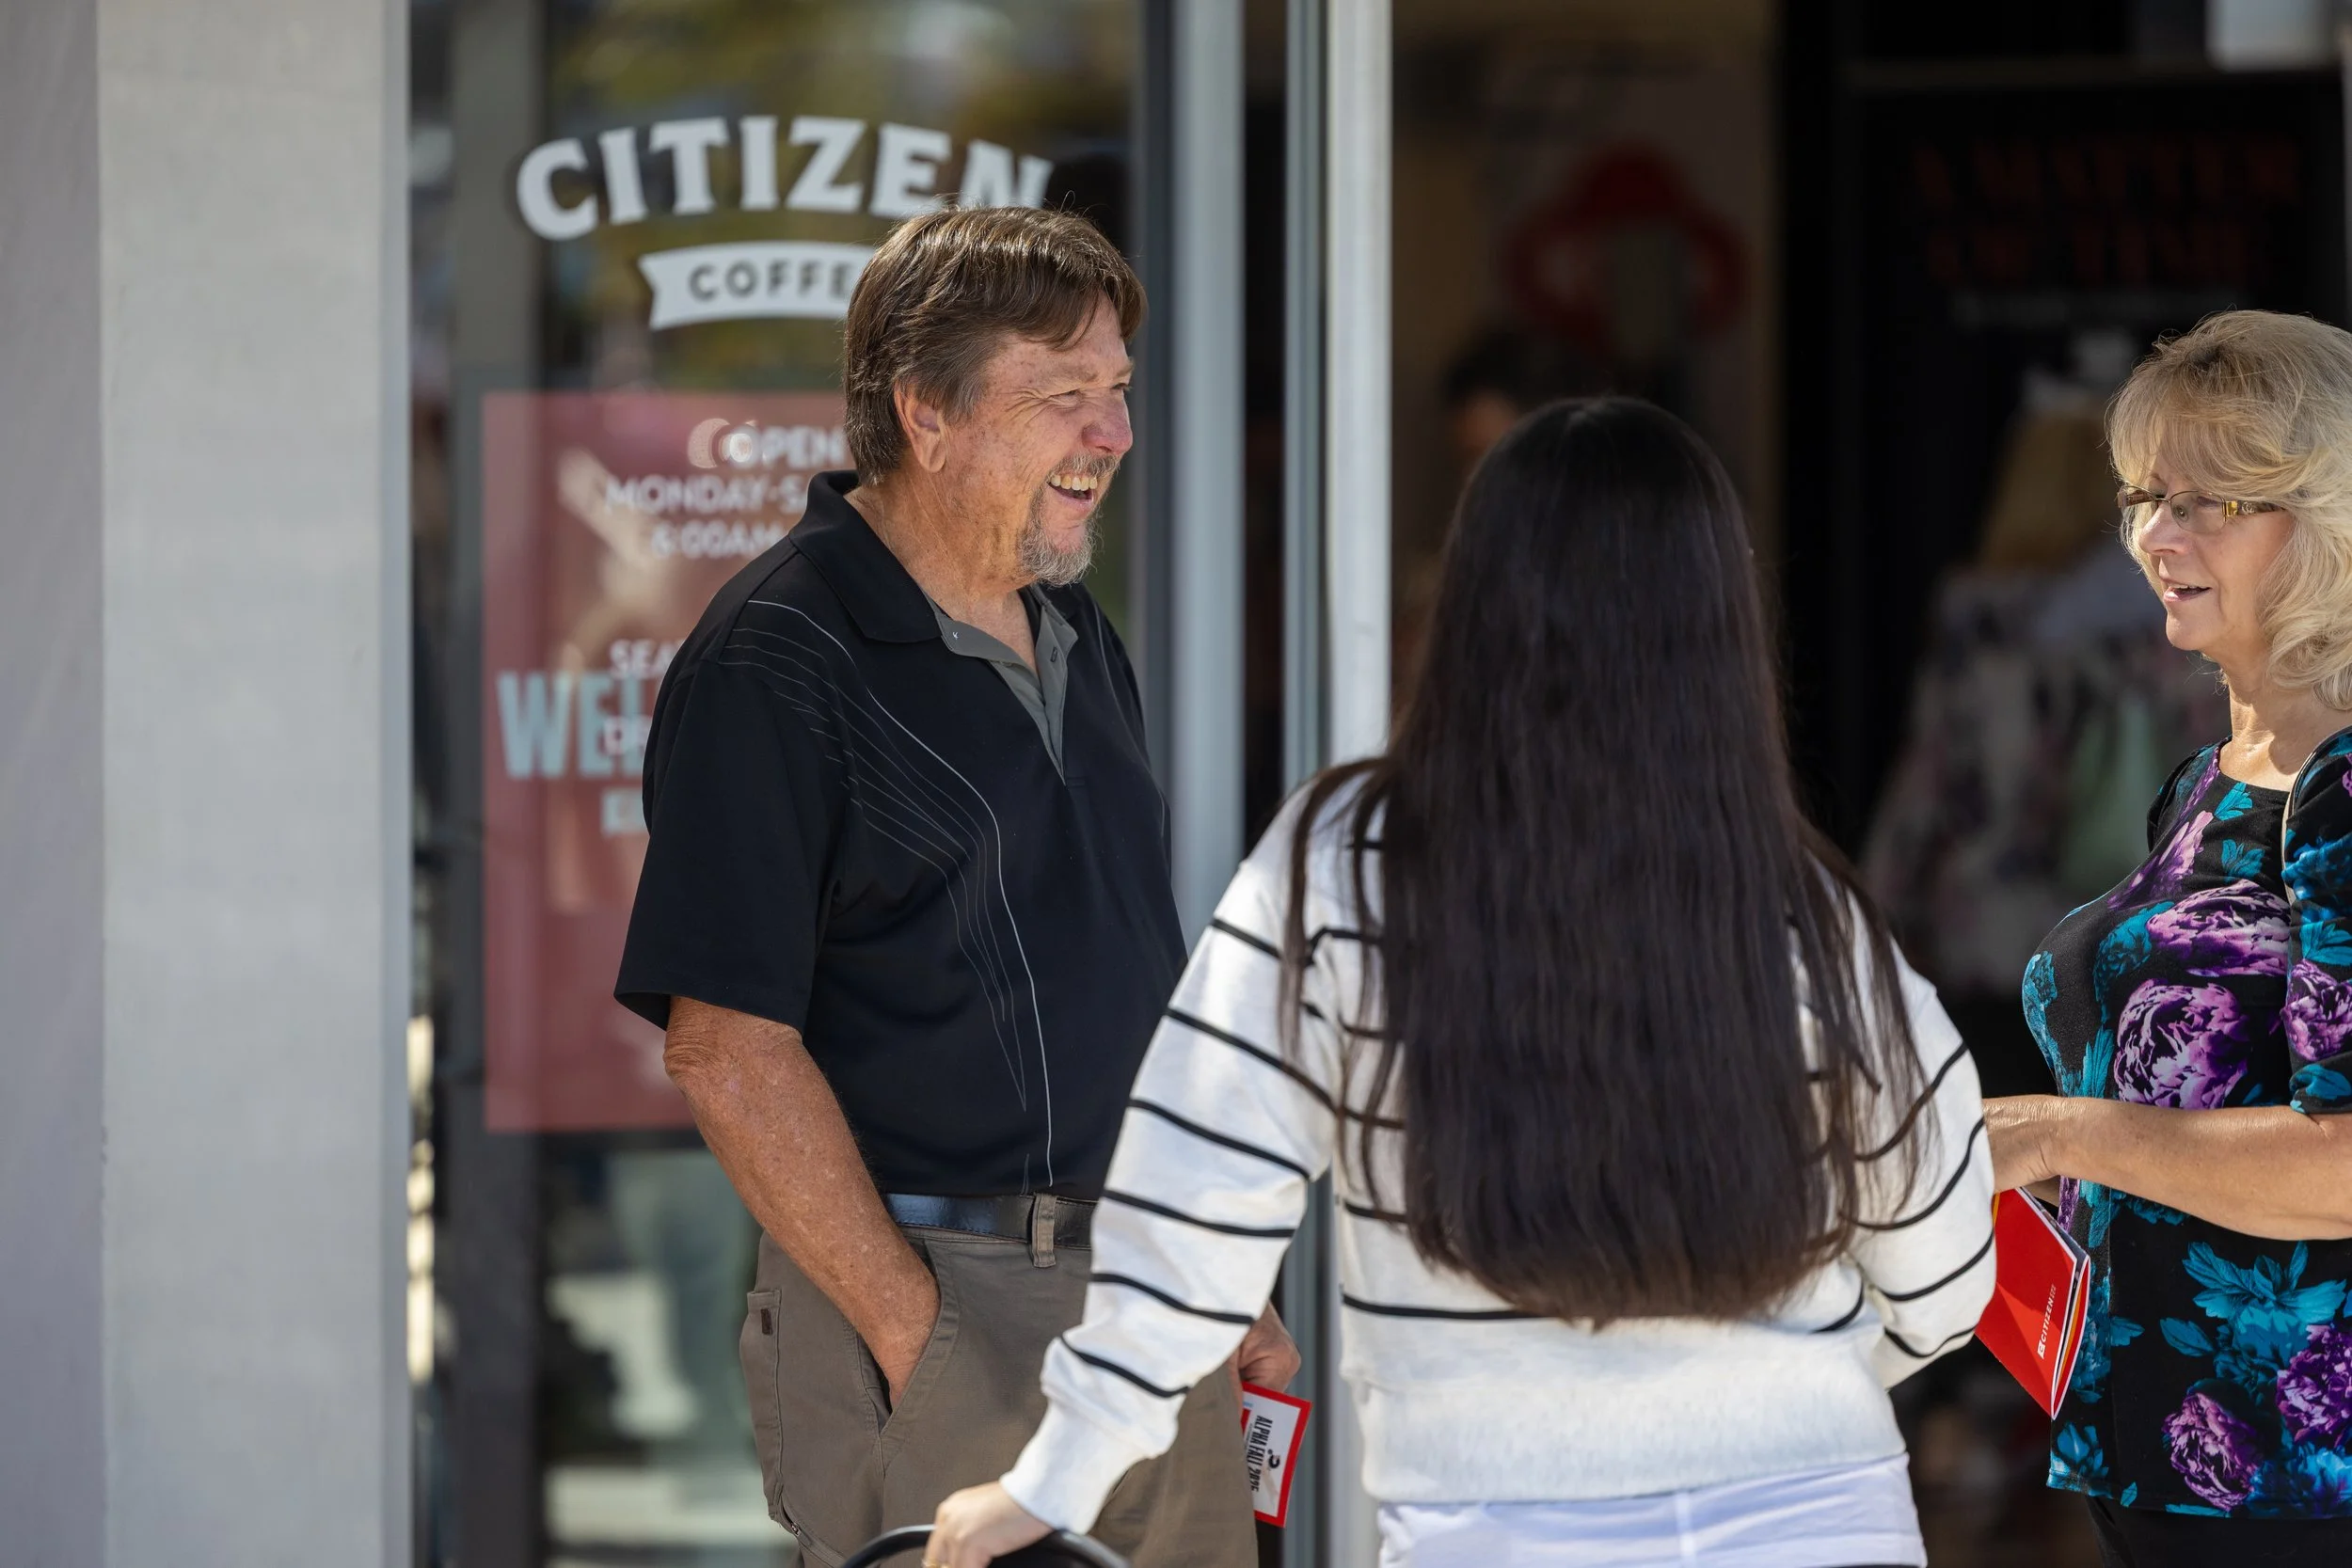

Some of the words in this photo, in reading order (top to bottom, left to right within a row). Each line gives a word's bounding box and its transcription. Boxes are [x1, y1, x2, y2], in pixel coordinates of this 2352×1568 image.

[516, 114, 1055, 241] CITIZEN
[2041, 1297, 2054, 1342] CITIZEN
[1250, 1415, 1273, 1446] ALPHA
[1247, 1445, 1266, 1466] FALL
